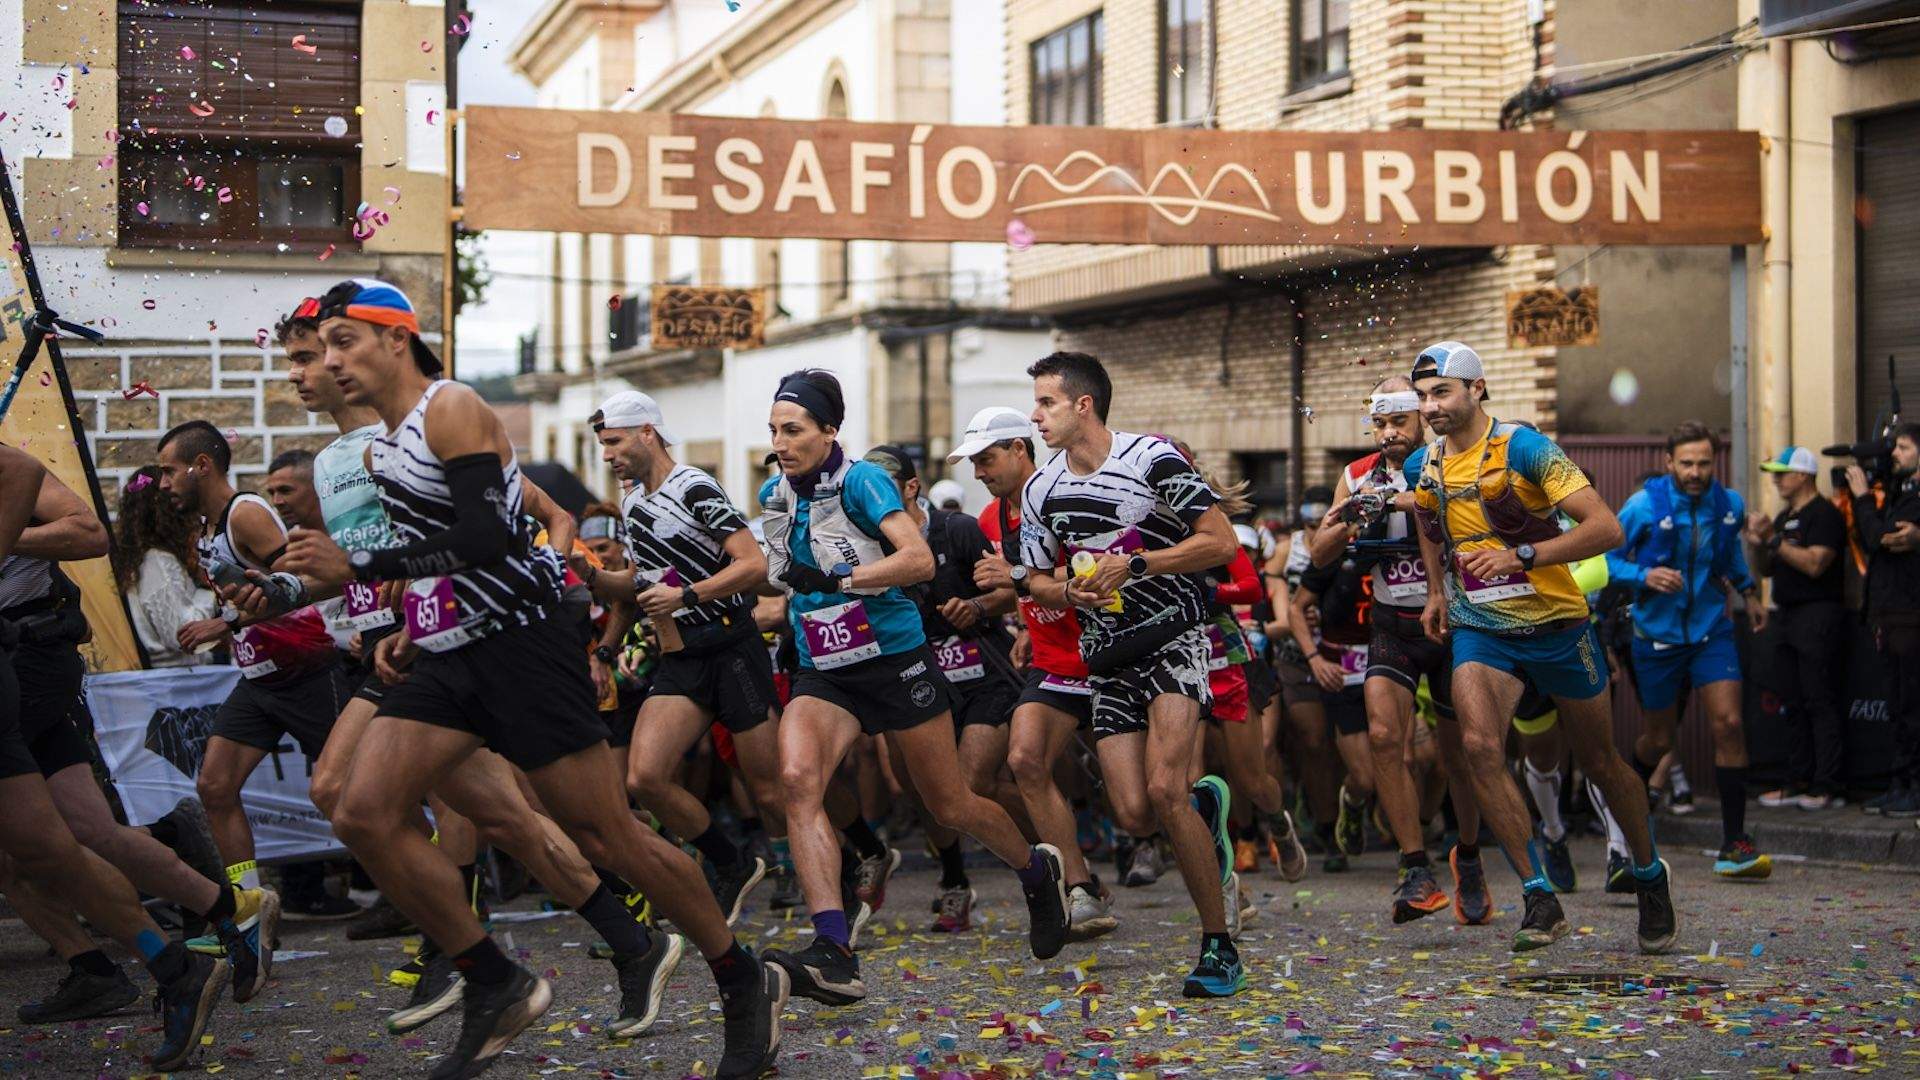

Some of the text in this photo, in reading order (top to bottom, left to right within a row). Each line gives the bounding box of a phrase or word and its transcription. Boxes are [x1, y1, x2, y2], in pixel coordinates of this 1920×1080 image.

[577, 125, 1661, 224] DESAFÍO URBIÓN
[835, 537, 860, 567] 226ER
[348, 584, 374, 609] 345
[416, 595, 440, 630] 657
[817, 621, 852, 649] 215
[934, 645, 965, 667] 393
